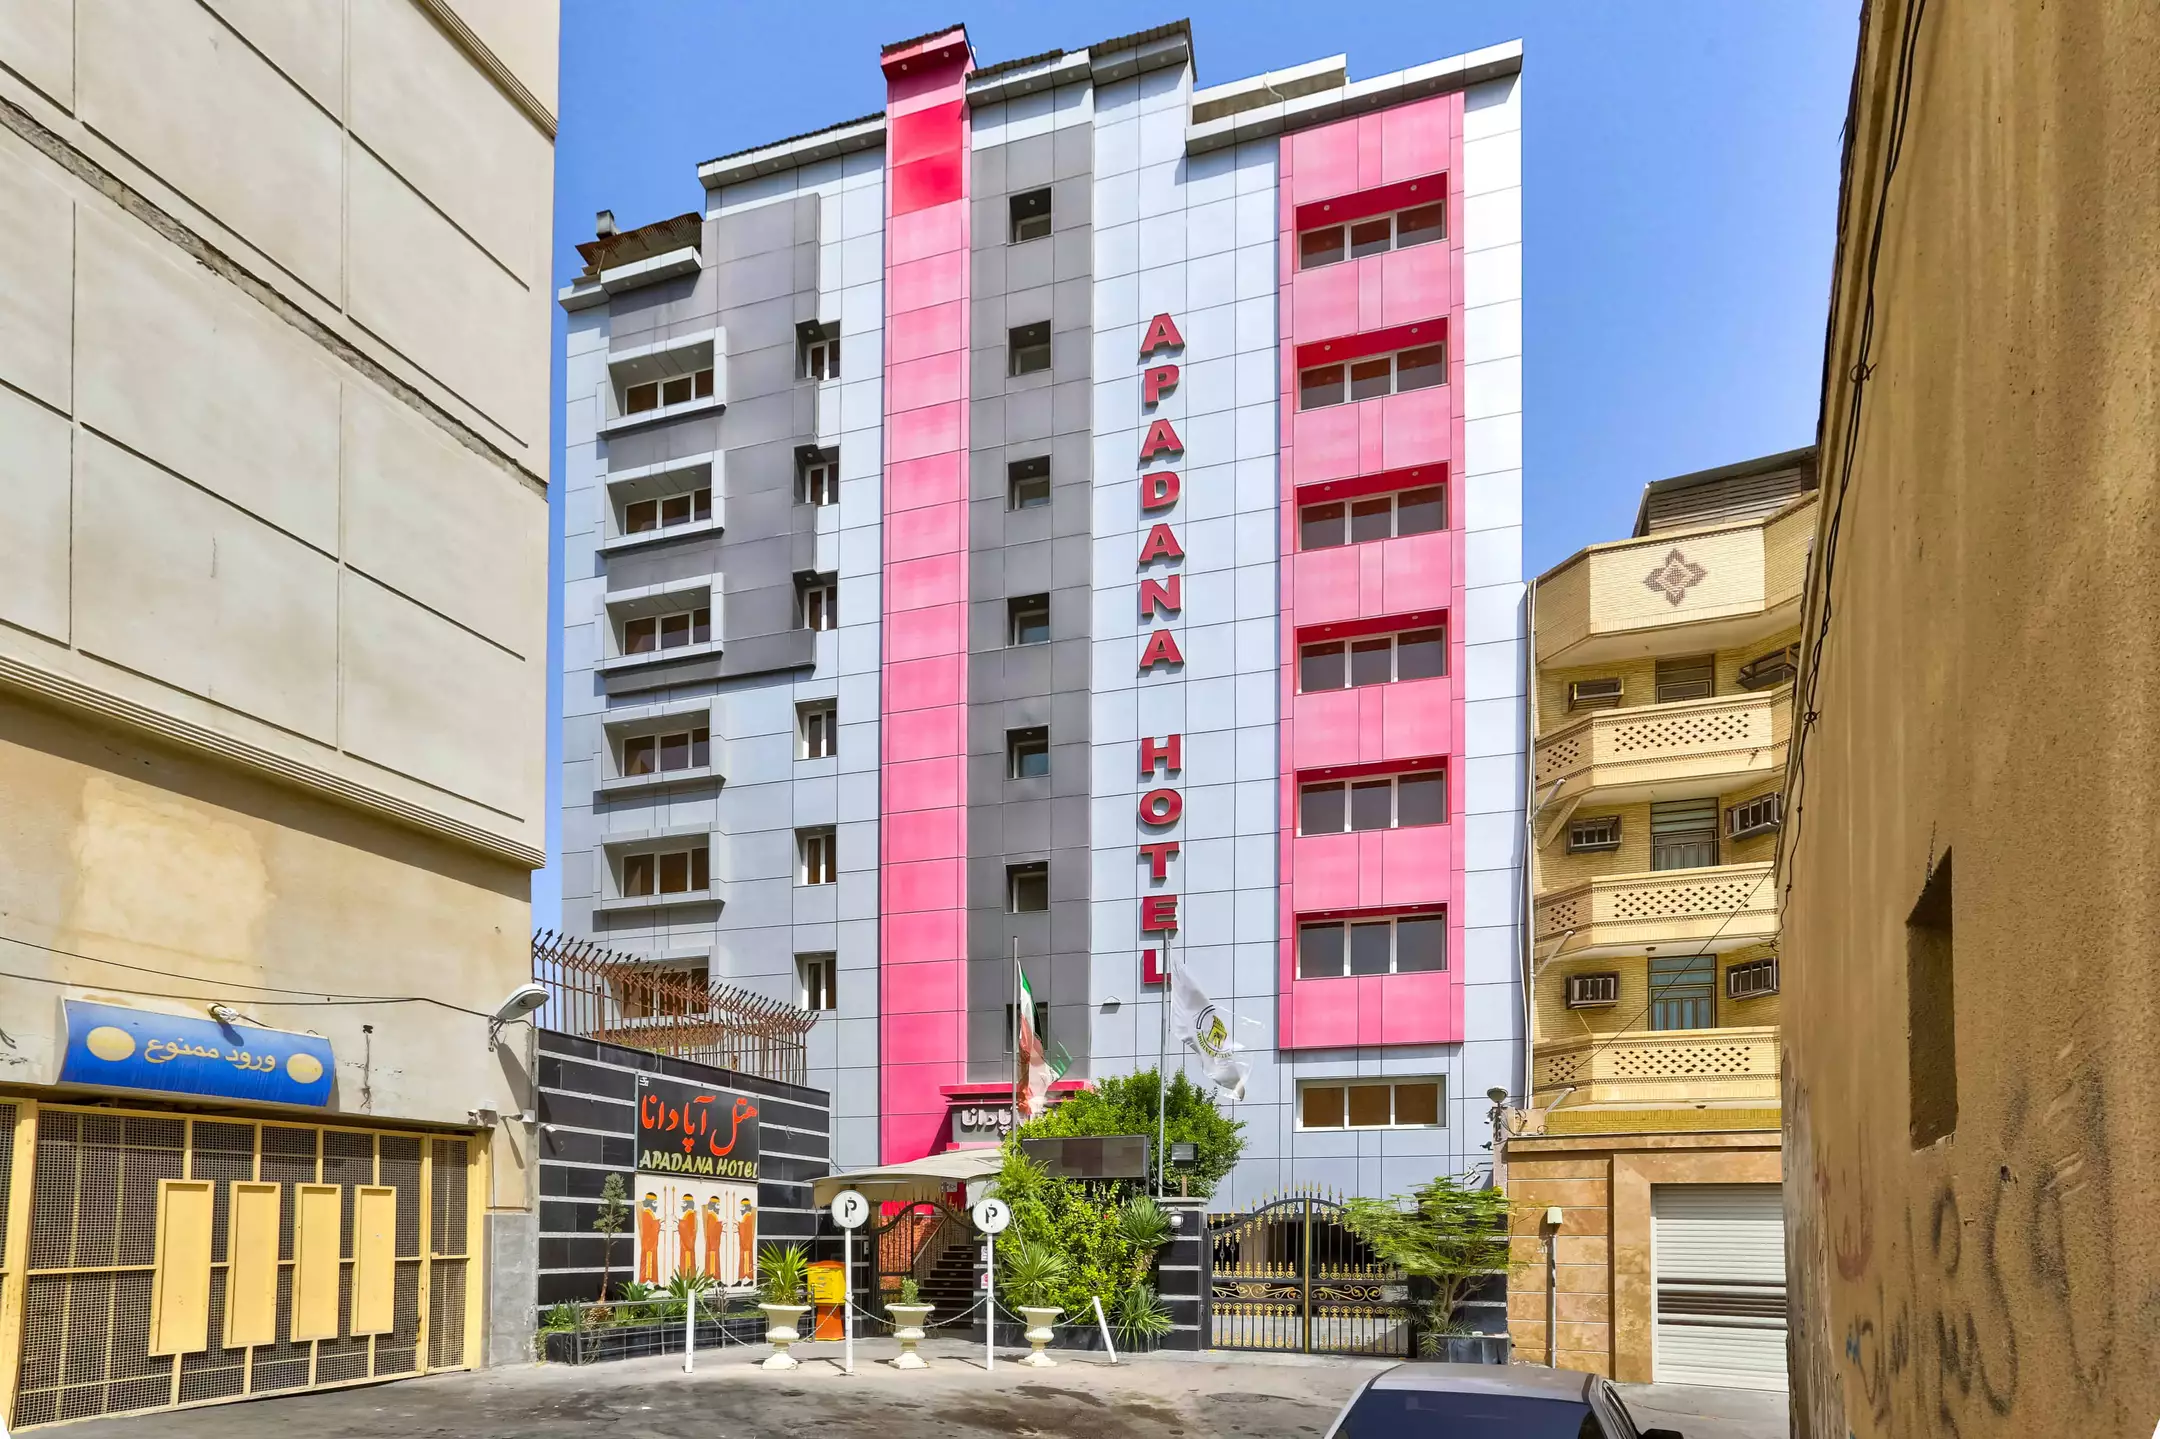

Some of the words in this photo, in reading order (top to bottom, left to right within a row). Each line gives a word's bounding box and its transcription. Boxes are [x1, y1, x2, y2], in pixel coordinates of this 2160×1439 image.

[1138, 312, 1186, 669] APADANA
[1138, 733, 1183, 985] HOTEL
[144, 1037, 220, 1063] ممنوع
[225, 1046, 276, 1072] ورود
[641, 1094, 717, 1153] آپادانا
[709, 1097, 758, 1157] هتل
[639, 1149, 714, 1175] APADANA
